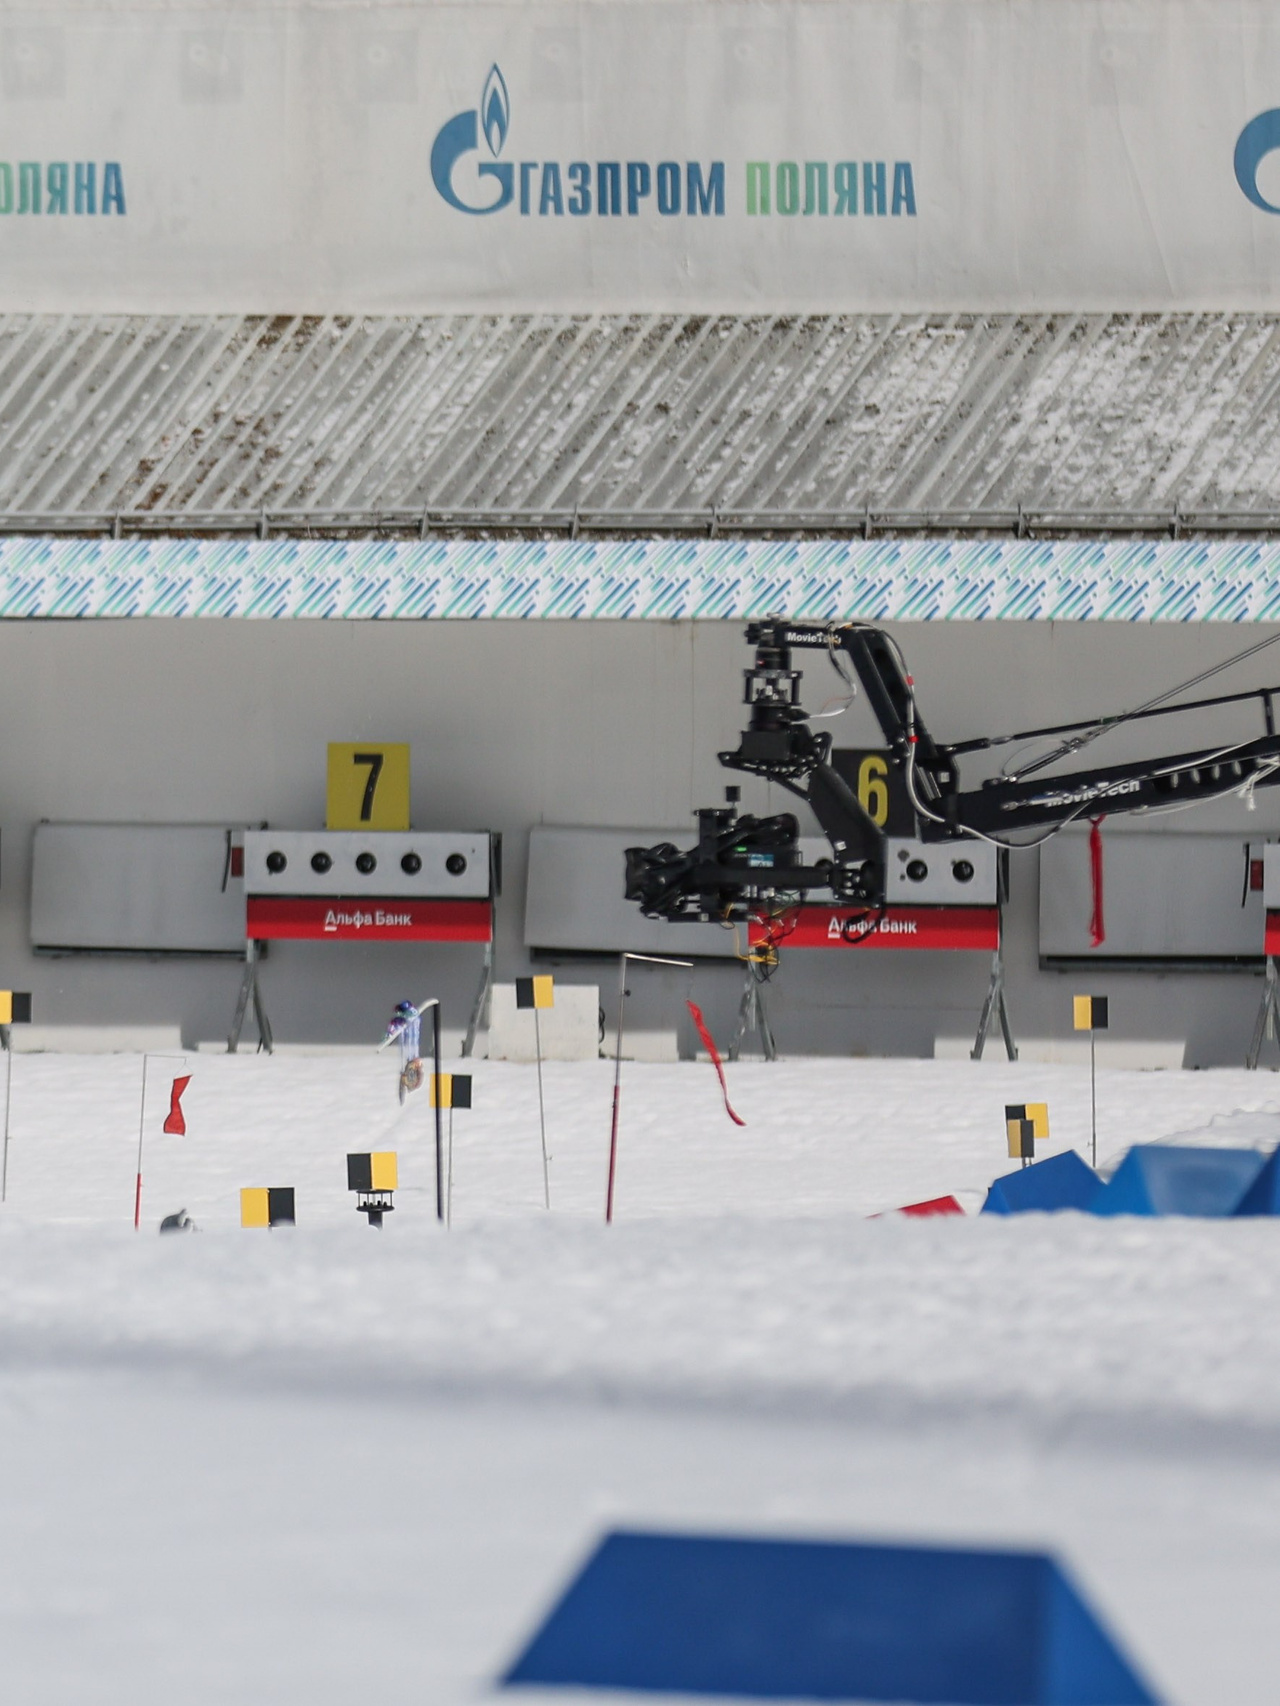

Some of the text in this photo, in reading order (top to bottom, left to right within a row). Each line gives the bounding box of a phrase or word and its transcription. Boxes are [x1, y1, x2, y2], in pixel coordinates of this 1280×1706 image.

[519, 161, 918, 216] ГАЗПРОМ ПОЛЯНА
[787, 632, 842, 644] MovieT
[353, 753, 384, 822] 7
[858, 754, 888, 828] 6
[324, 911, 412, 930] Альфа Банк
[880, 918, 917, 934] Банк
